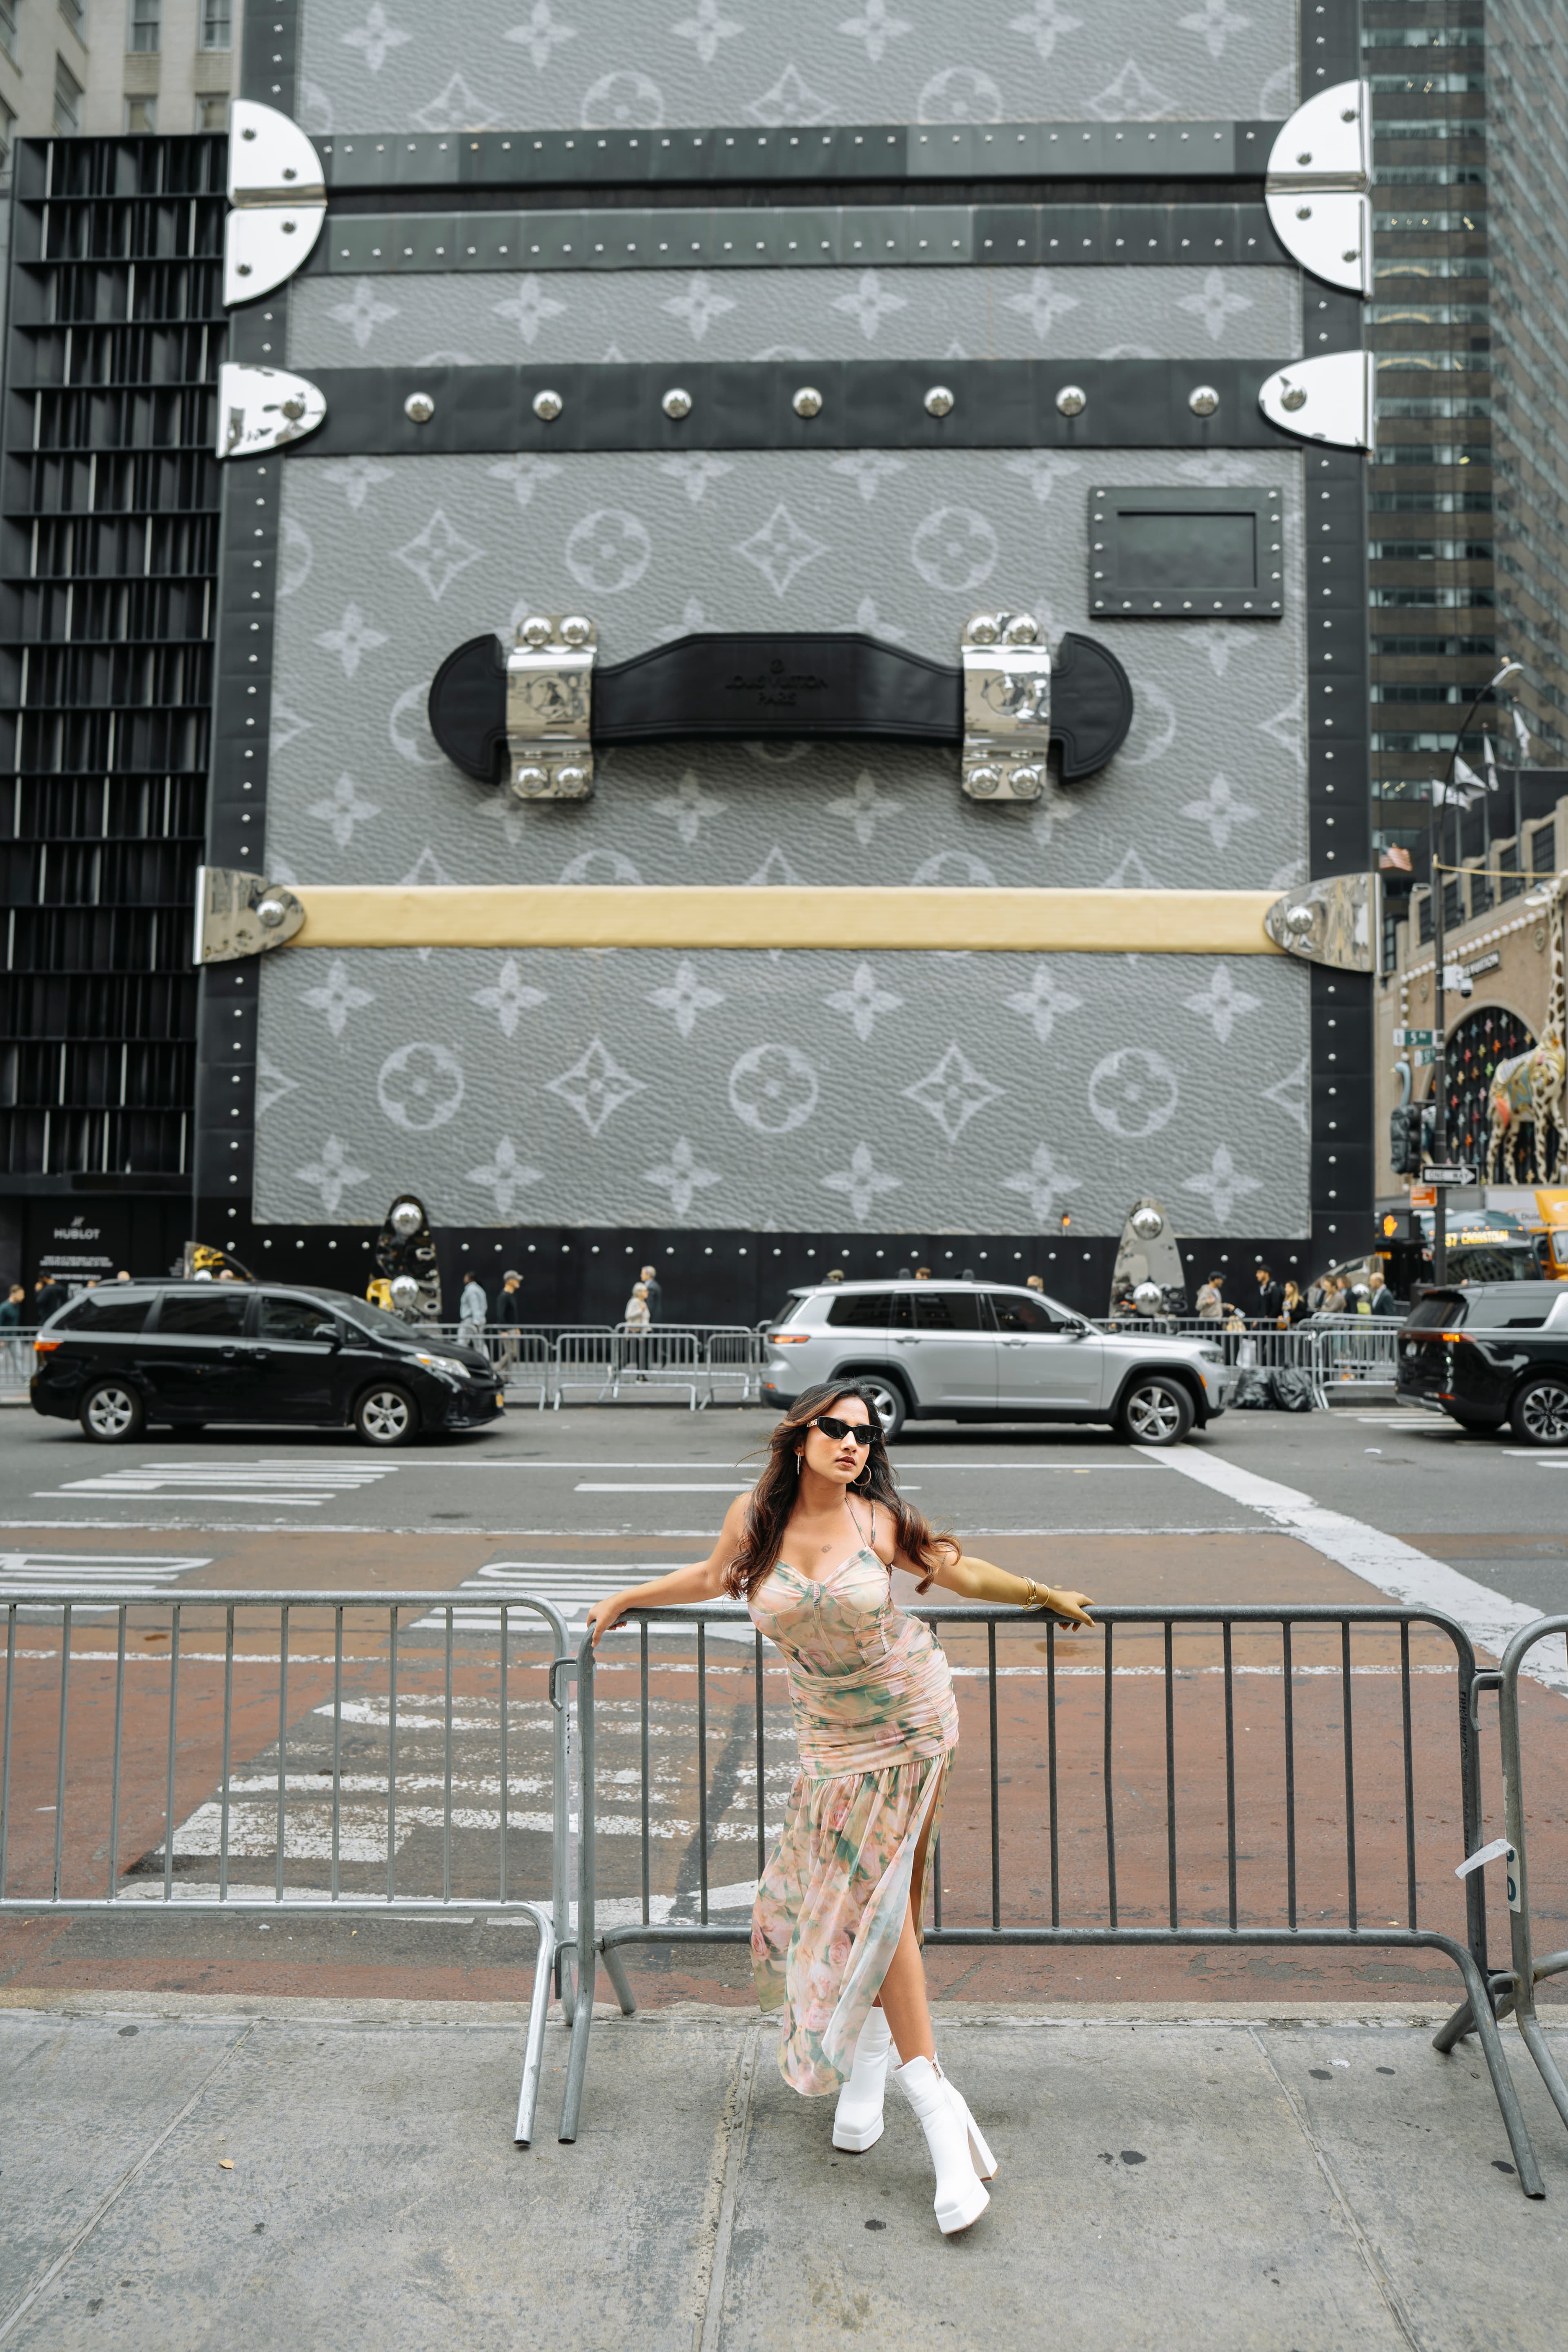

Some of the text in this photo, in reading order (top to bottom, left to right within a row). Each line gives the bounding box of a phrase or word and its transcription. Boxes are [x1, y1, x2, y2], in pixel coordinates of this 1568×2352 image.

[1410, 1031, 1417, 1045] 5
[1430, 1170, 1469, 1182] ONE WAY
[54, 1228, 101, 1240] HUBLOT
[1461, 1230, 1509, 1245] CROSSTOWN
